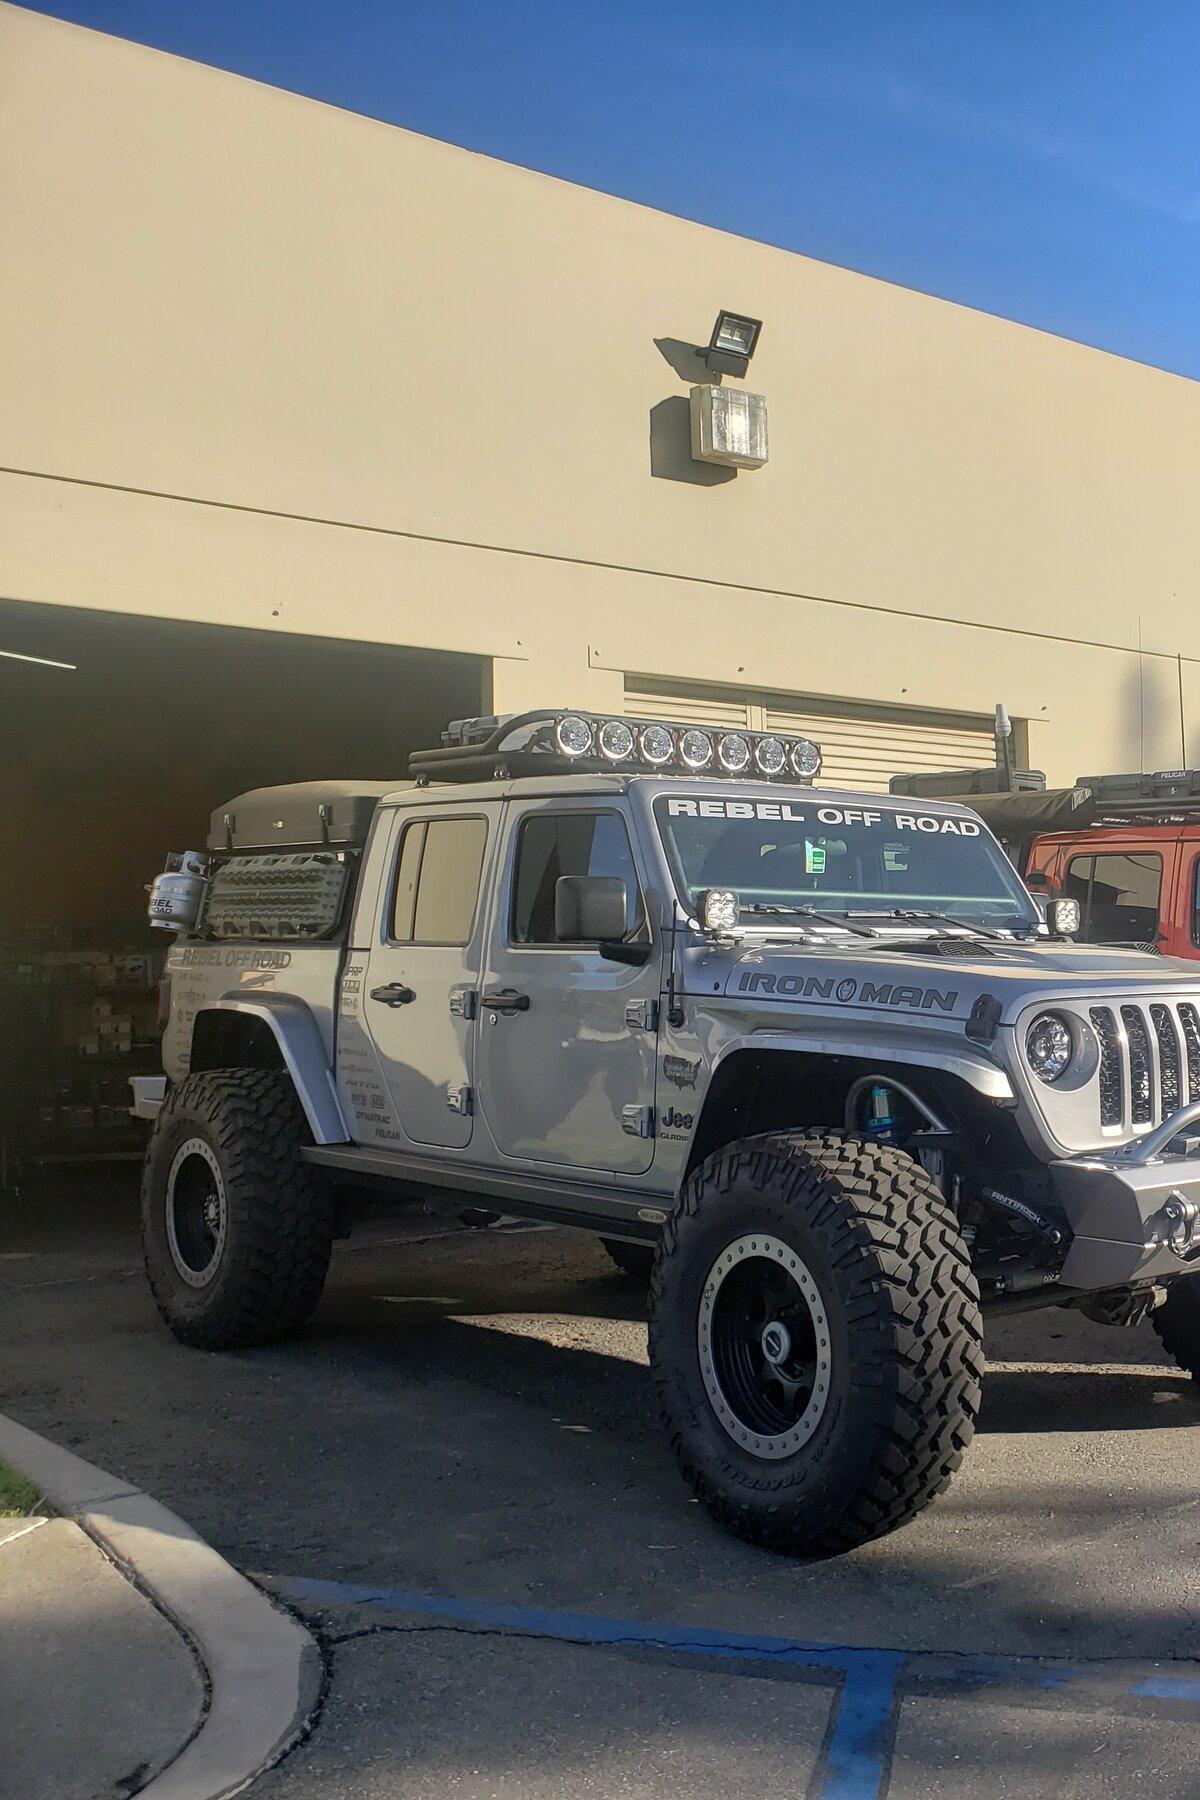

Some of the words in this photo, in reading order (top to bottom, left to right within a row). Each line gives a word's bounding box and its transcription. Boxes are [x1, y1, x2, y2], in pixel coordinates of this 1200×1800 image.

[1160, 771, 1187, 779] PELICAN
[667, 799, 805, 822] REBEL
[817, 807, 882, 827] OFF
[895, 814, 981, 838] ROAD
[181, 949, 223, 967] REBEL
[225, 950, 252, 968] OFF
[252, 950, 292, 969] ROAD
[738, 972, 836, 999] IRON
[858, 982, 959, 1011] MAN
[661, 1106, 695, 1129] Jee
